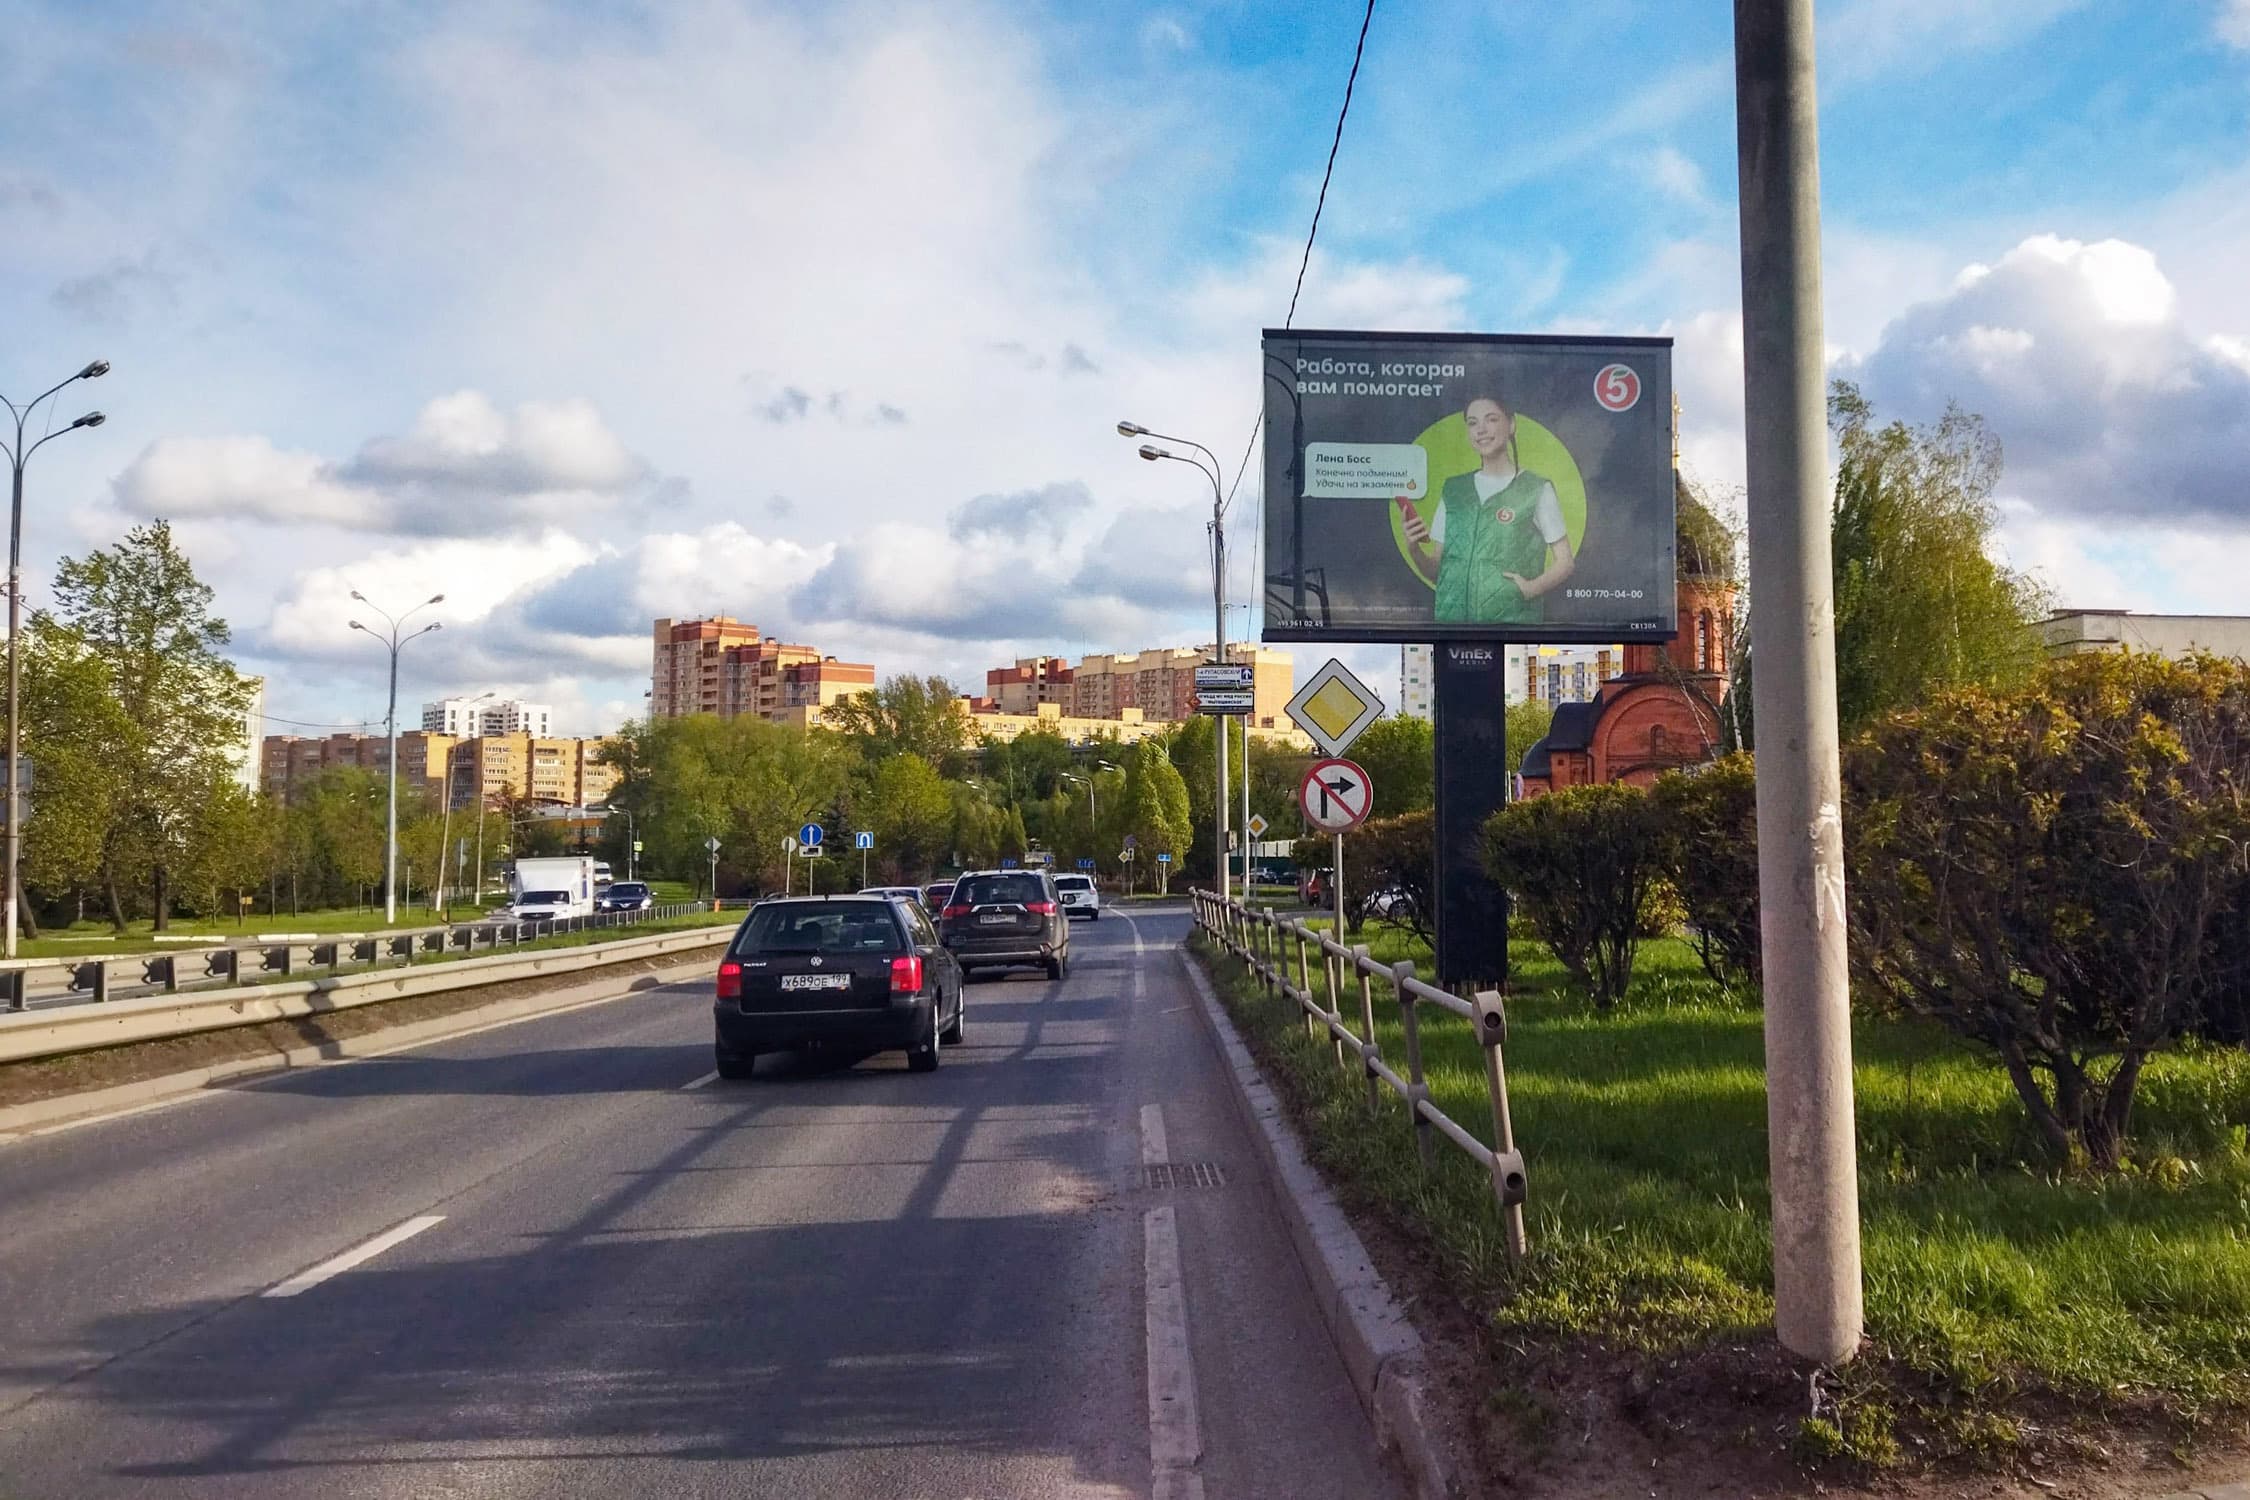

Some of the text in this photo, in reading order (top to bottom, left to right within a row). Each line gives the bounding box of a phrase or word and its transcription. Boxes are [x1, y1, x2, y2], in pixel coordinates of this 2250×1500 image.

[1296, 357, 1466, 380] Работа, которая
[1296, 381, 1444, 397] вам помогает
[1315, 453, 1372, 464] Лена Босс
[1315, 468, 1408, 479] Конечно подменим!
[1315, 479, 1345, 489] Удачи
[1346, 481, 1359, 489] на
[1566, 588, 1644, 599] 8 800 770-04-00
[1448, 647, 1493, 660] VinEx
